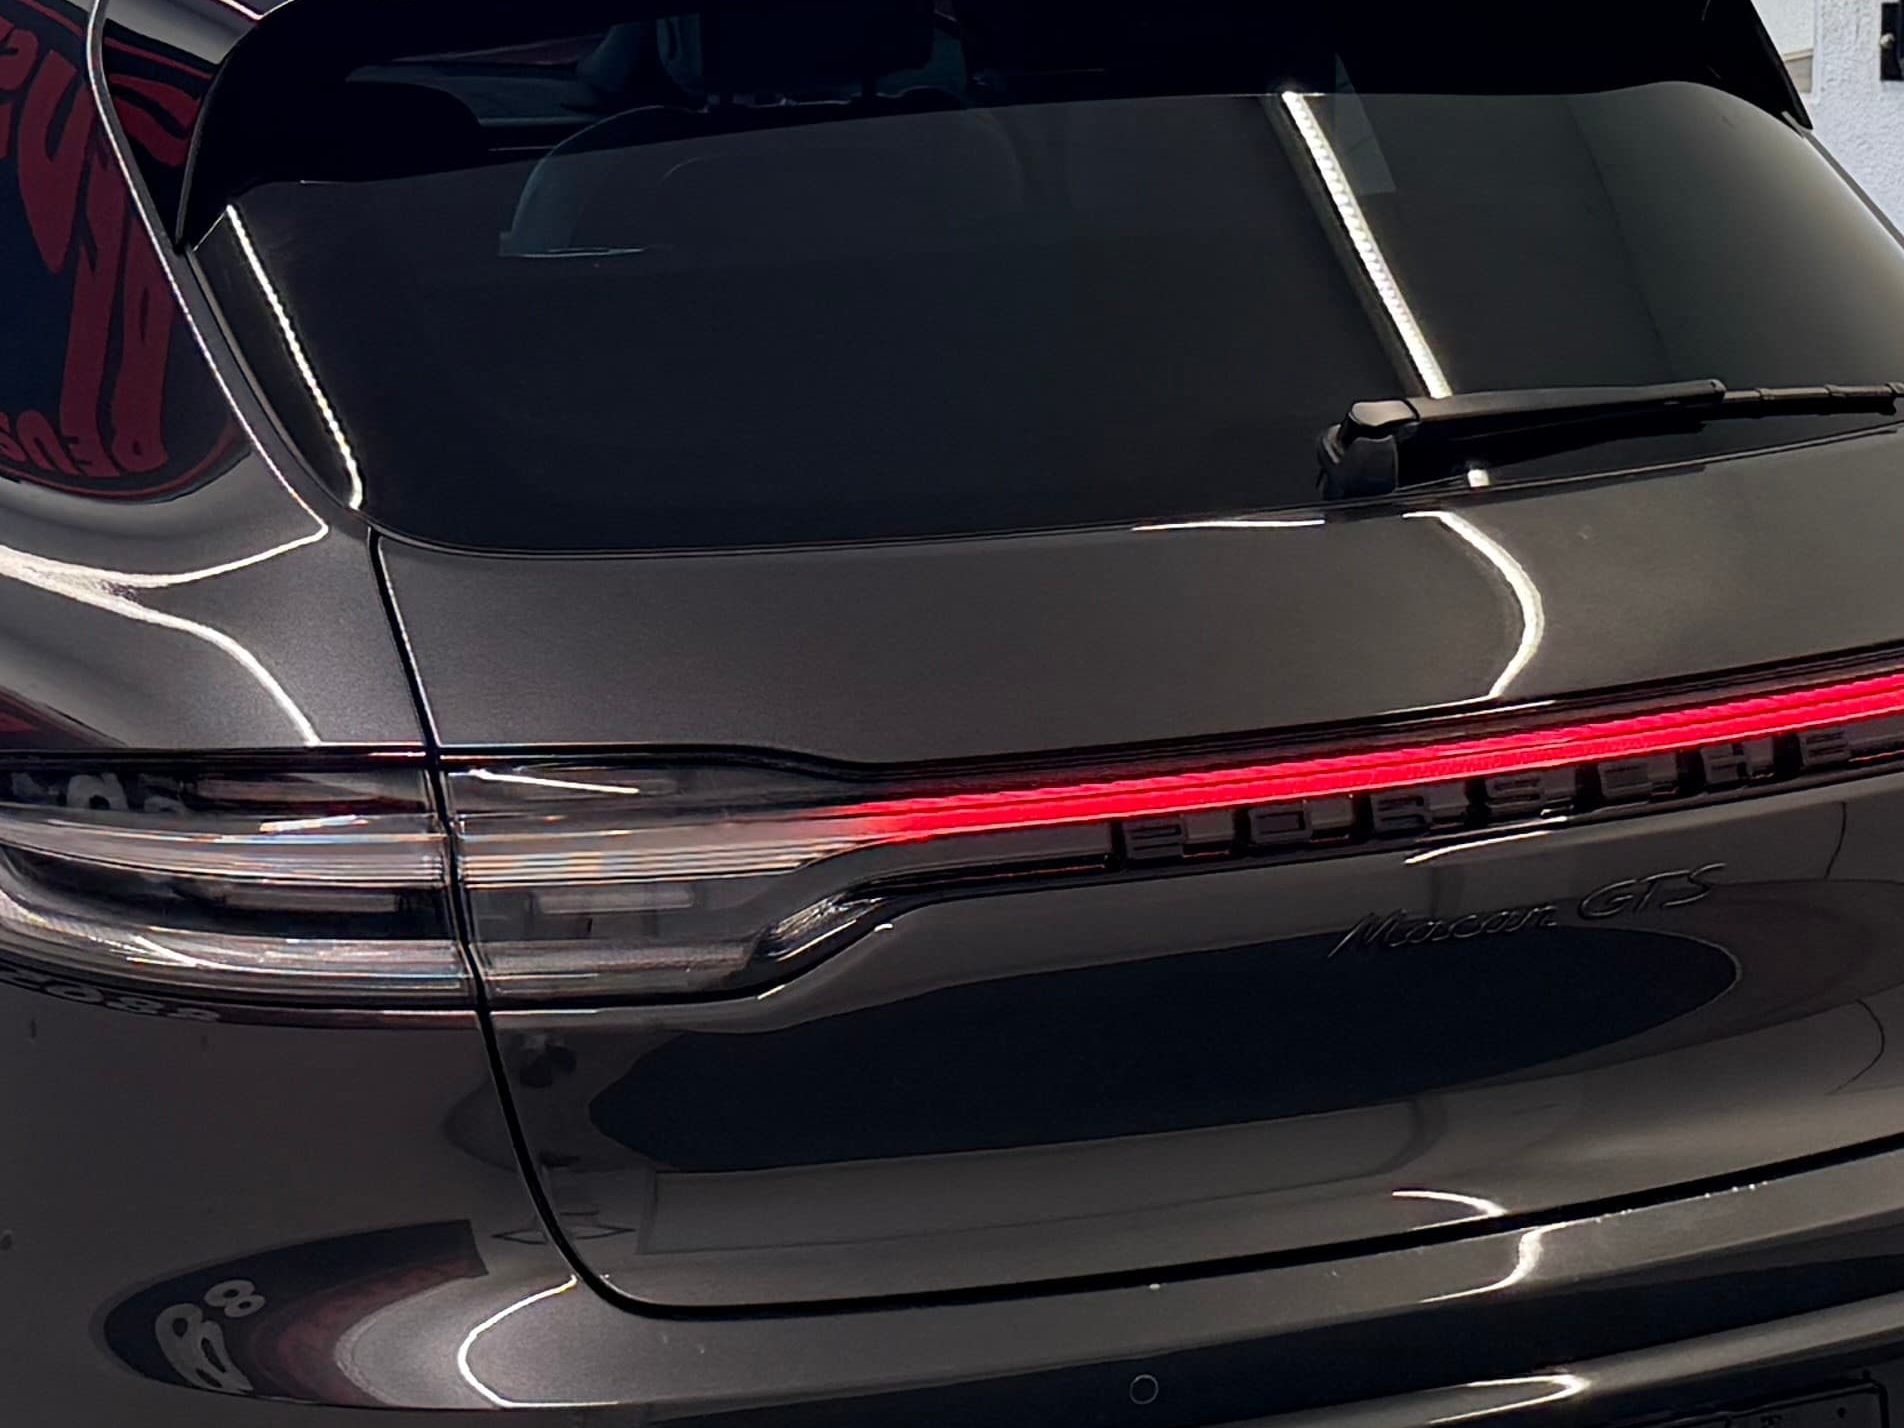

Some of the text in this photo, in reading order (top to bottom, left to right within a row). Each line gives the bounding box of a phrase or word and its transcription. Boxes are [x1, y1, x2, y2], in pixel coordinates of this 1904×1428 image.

[1122, 723, 1850, 860] PORSCHE
[1328, 862, 1725, 958] Macan GTS
